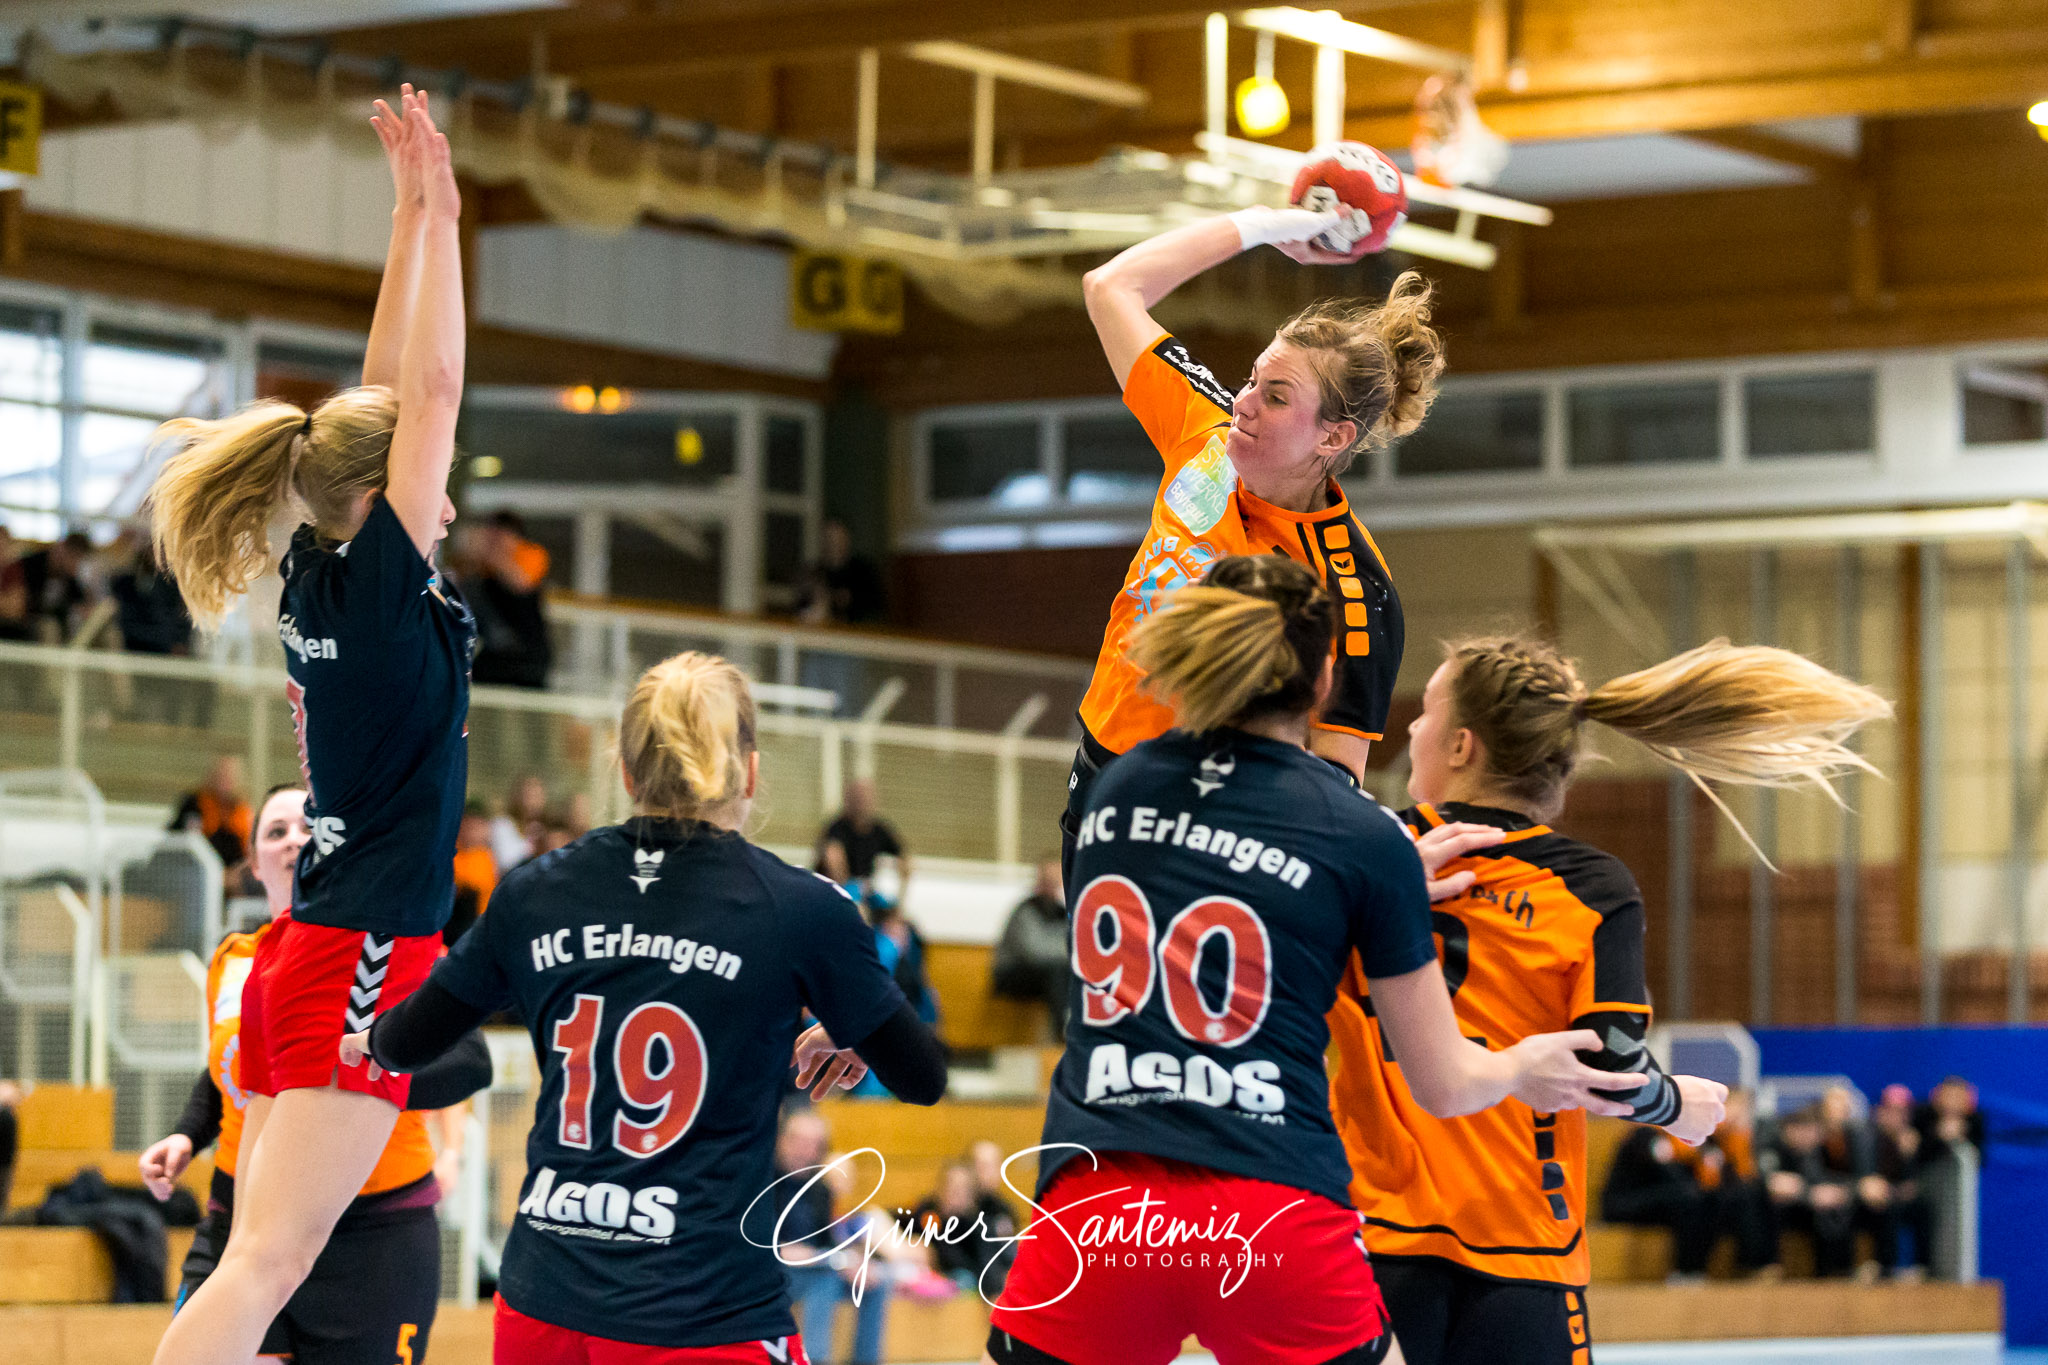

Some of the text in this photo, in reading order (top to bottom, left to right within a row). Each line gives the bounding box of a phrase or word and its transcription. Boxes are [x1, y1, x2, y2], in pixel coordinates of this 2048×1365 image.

[1170, 481, 1209, 529] Bayreuth
[1076, 806, 1312, 889] HC Erlangen
[531, 923, 742, 981] HC Erlangen
[1071, 874, 1273, 1048] 90
[553, 993, 709, 1159] 19
[519, 1166, 679, 1238] AGOS
